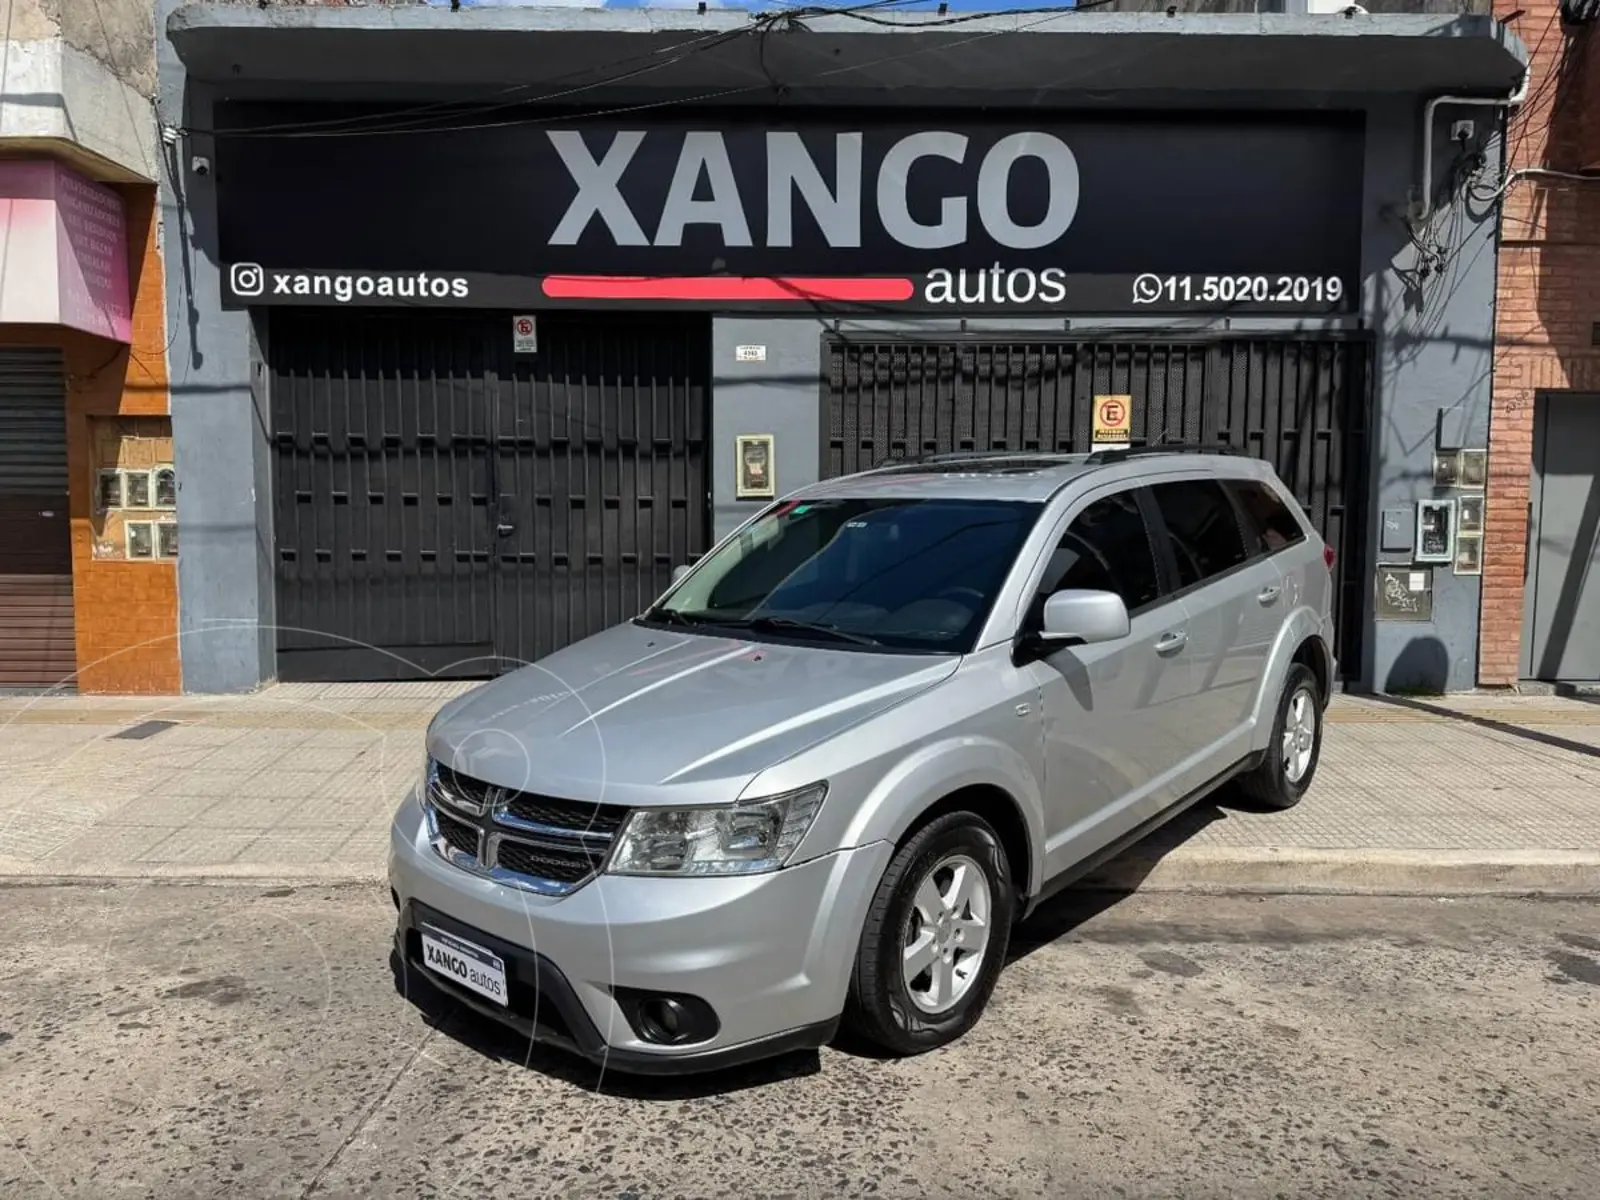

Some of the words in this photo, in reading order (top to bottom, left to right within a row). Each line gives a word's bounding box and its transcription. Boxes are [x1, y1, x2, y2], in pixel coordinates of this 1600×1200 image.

[545, 130, 1080, 249] XANGO
[272, 272, 469, 302] xangoautos
[924, 261, 1067, 304] autos
[1163, 275, 1344, 302] 11.5020.2019
[427, 944, 467, 979] XANGO
[470, 968, 501, 995] autos
